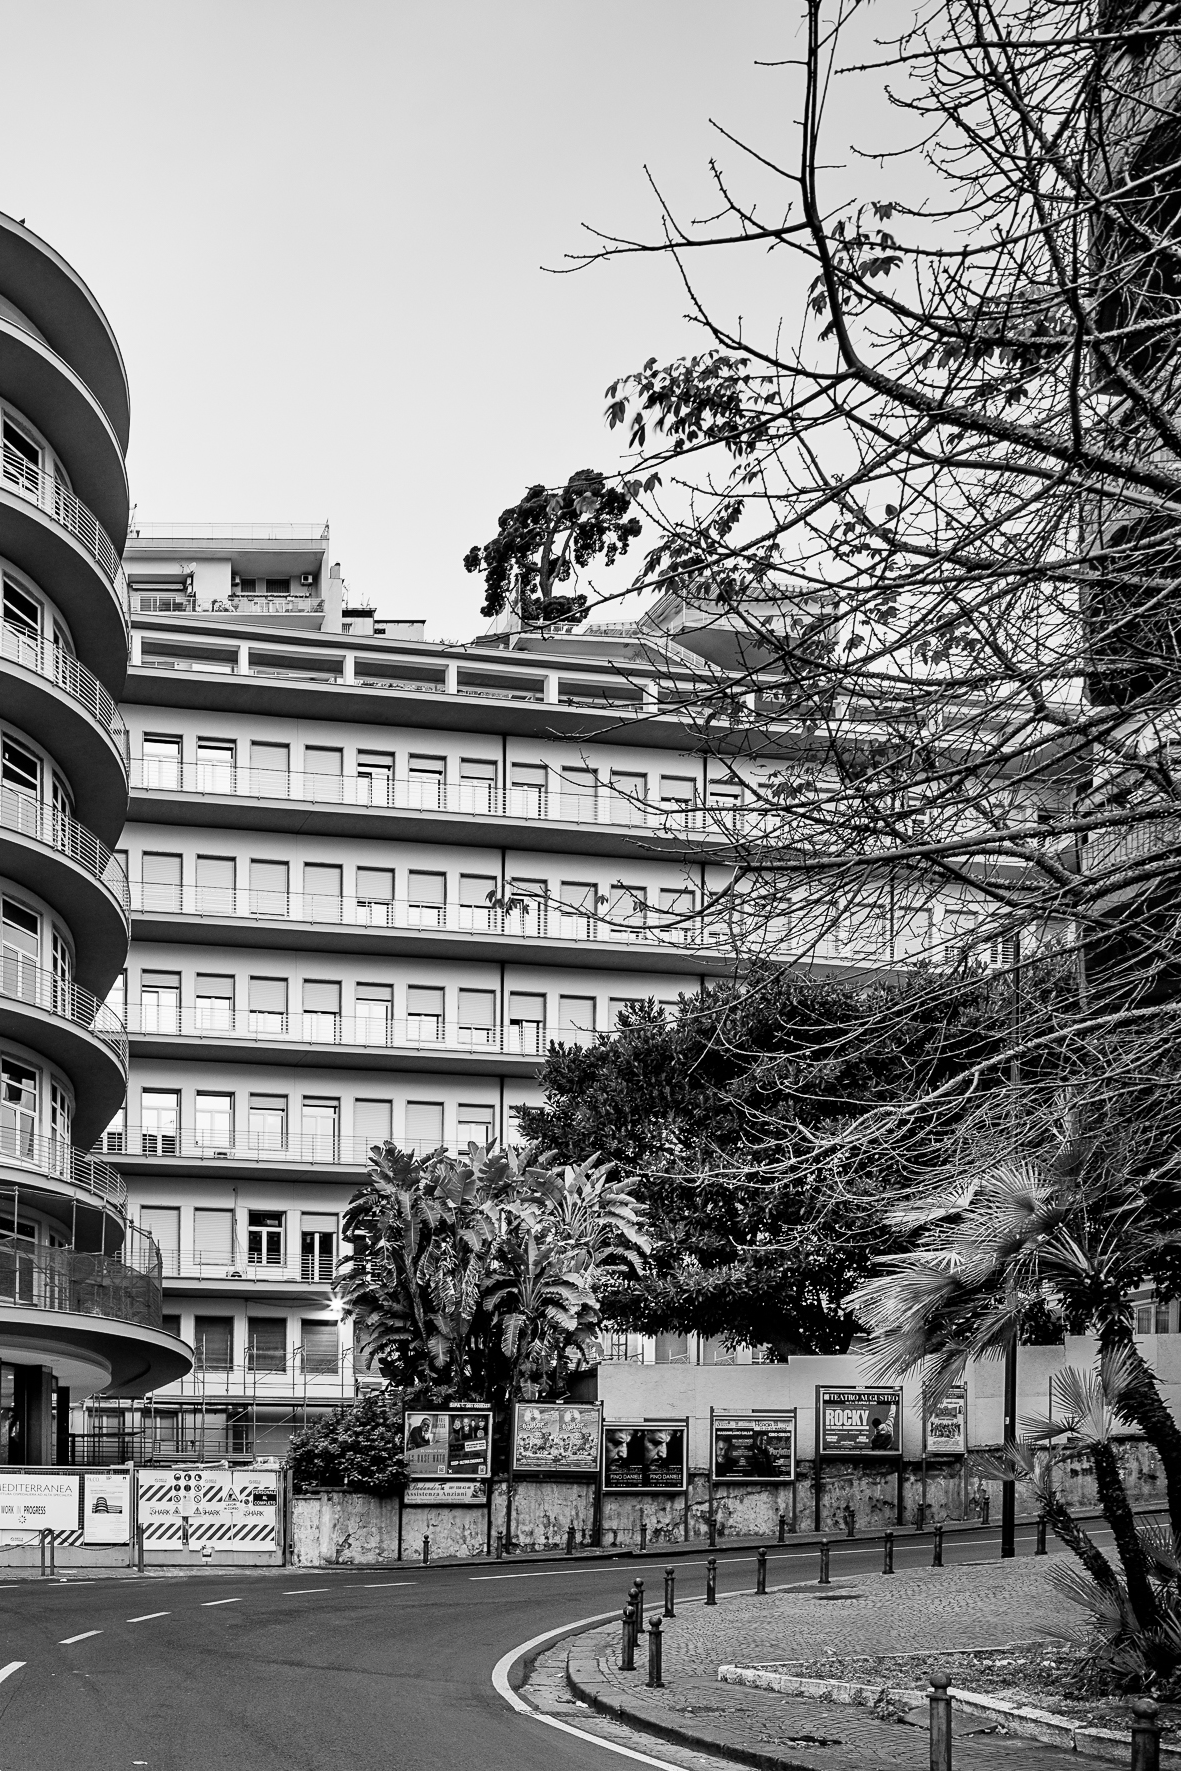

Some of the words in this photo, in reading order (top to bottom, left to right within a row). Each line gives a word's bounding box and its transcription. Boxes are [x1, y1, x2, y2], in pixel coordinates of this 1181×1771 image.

[829, 1393, 859, 1401] TEATRO
[861, 1394, 899, 1402] AUGUSTEO
[825, 1409, 869, 1426] ROCKY
[0, 1505, 14, 1515] WORK
[17, 1505, 22, 1514] IN
[23, 1505, 46, 1515] PROGRESS
